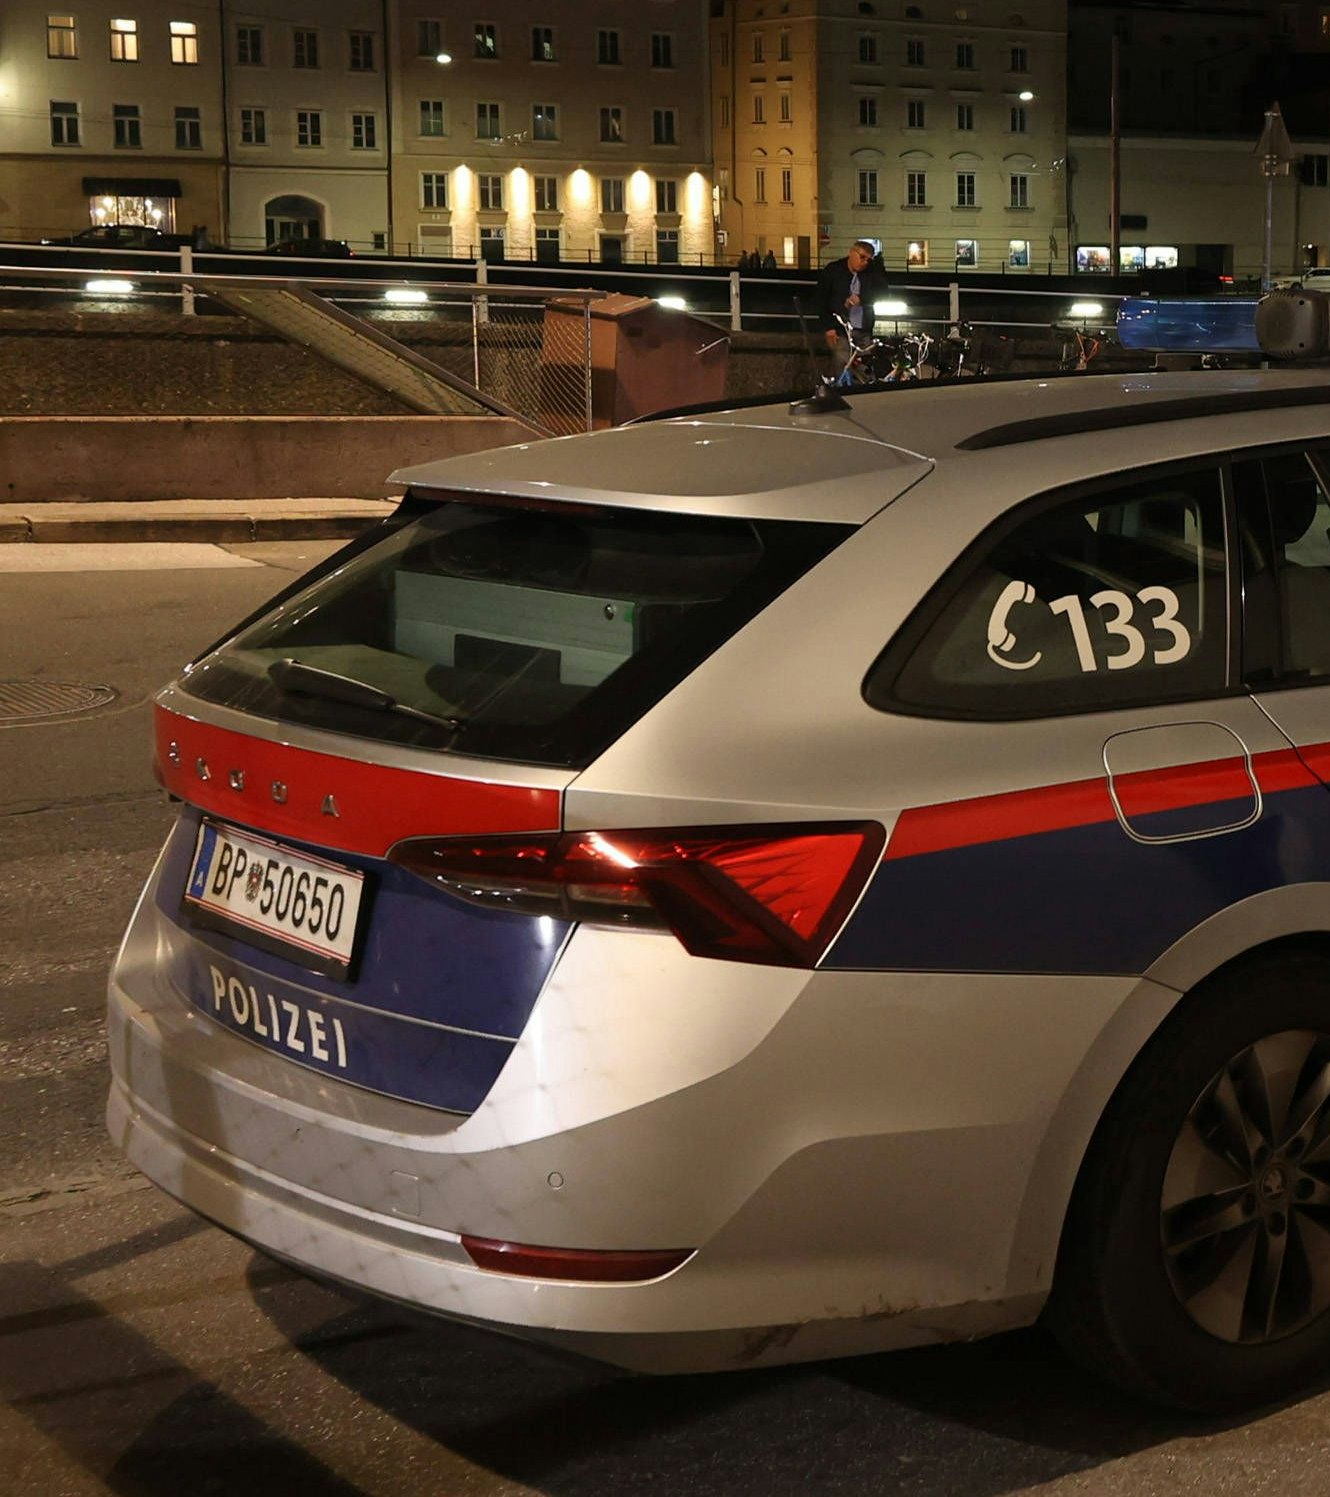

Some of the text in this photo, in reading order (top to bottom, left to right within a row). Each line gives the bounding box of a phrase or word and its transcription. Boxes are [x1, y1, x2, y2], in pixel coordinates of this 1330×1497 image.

[1049, 586, 1190, 672] 133
[195, 871, 204, 887] A
[212, 842, 345, 941] BP 50650
[210, 964, 348, 1068] POLIZEI
